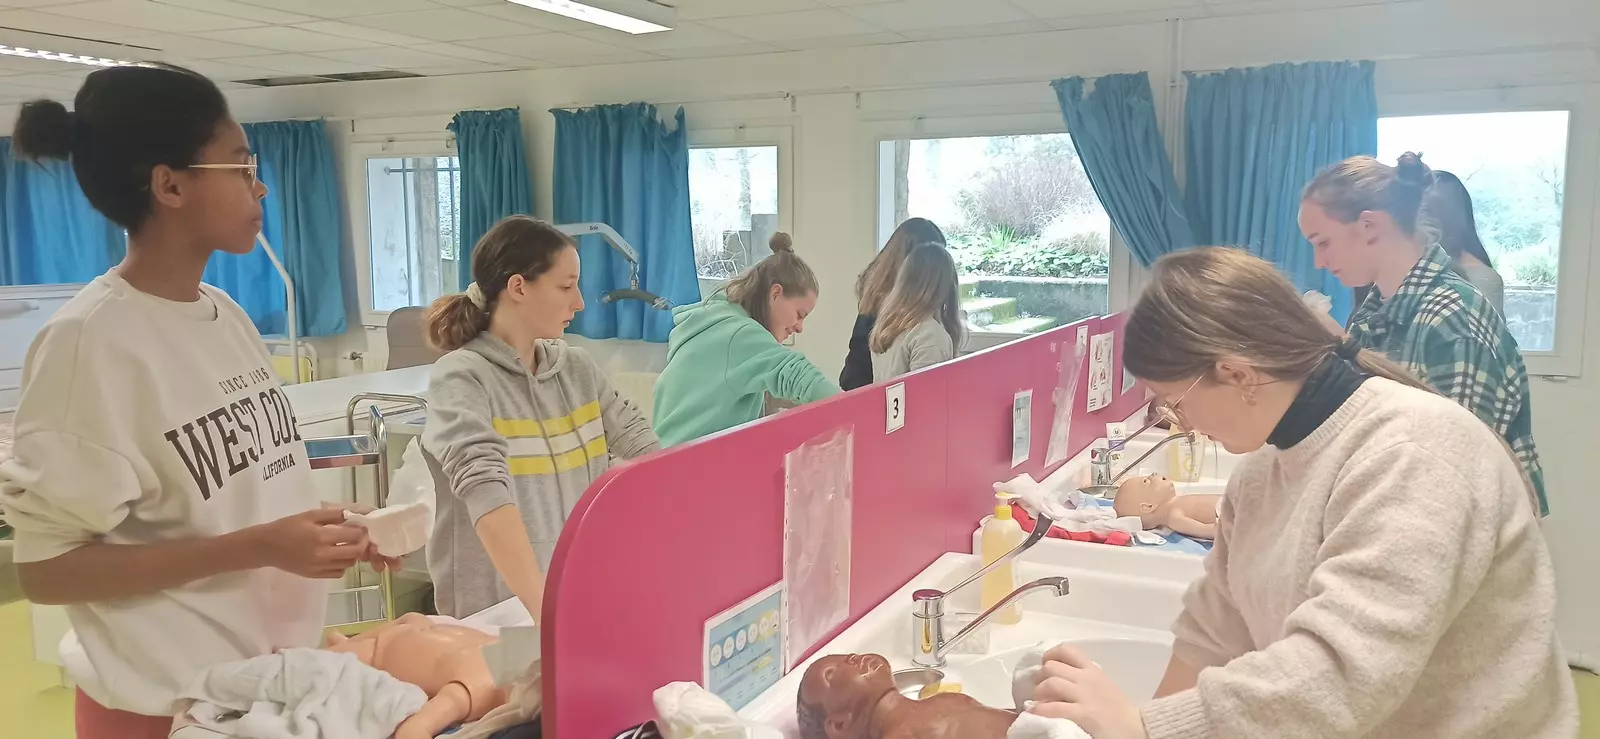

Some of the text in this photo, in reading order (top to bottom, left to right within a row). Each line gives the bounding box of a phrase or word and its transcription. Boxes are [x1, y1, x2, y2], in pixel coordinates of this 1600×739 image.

[218, 375, 248, 395] SINCE
[893, 397, 899, 419] 3
[164, 397, 264, 501] WEST
